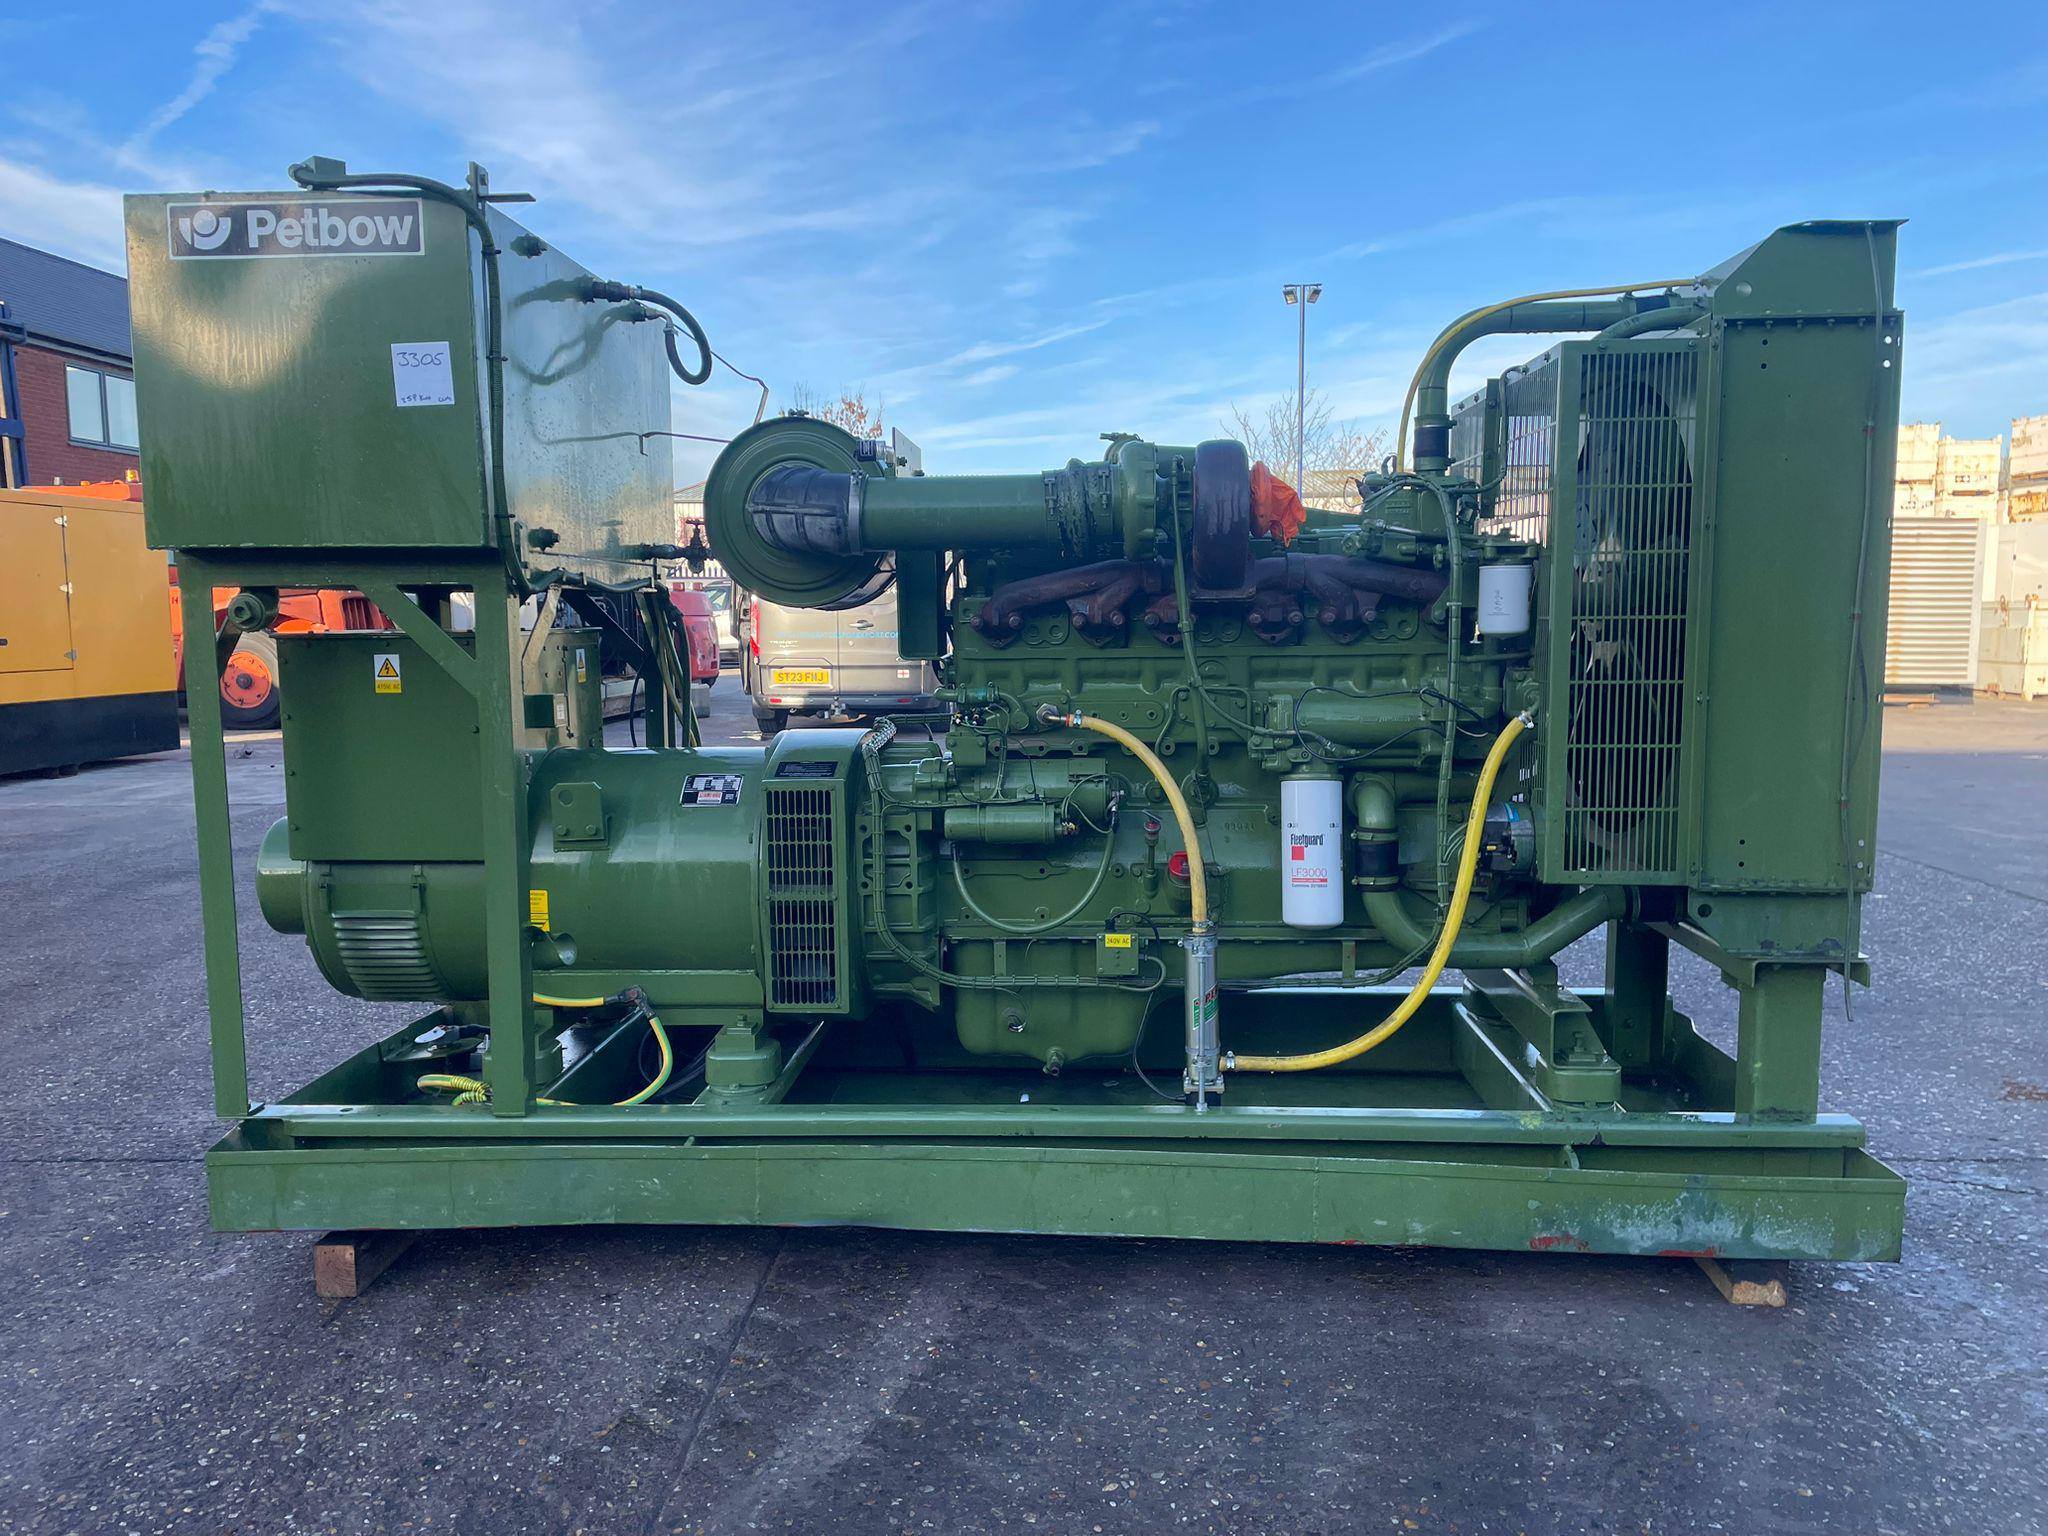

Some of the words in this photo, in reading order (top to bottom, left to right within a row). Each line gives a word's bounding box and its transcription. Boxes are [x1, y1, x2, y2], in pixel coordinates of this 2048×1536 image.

[247, 208, 413, 248] Petbow
[397, 352, 444, 368] 3305
[778, 671, 803, 682] ST23
[1290, 833, 1324, 848] Fleetguard
[1291, 867, 1328, 878] LF3000
